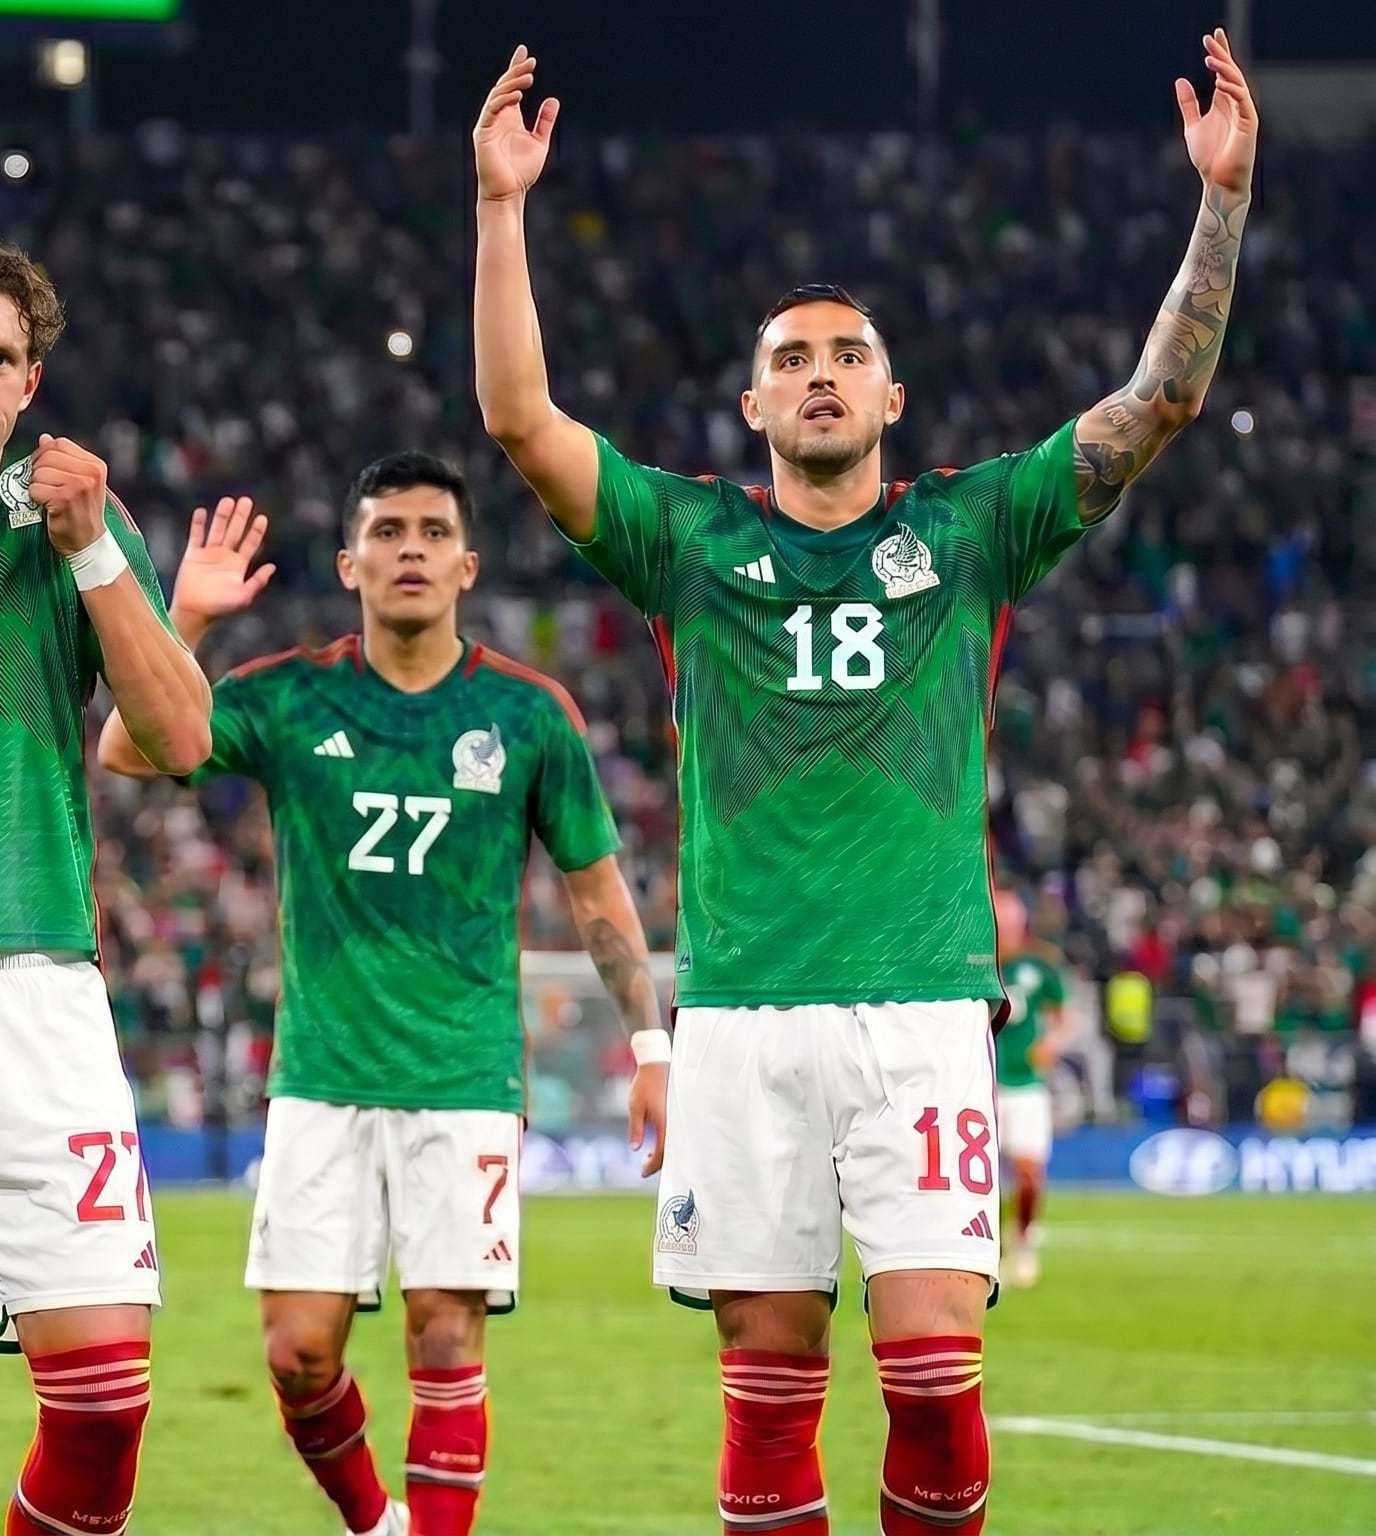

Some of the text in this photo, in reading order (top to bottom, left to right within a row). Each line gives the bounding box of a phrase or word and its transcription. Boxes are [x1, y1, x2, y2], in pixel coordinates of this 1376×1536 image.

[782, 602, 886, 691] 18
[348, 791, 452, 875] 27
[477, 1154, 509, 1225] 7
[913, 1106, 994, 1195] 18
